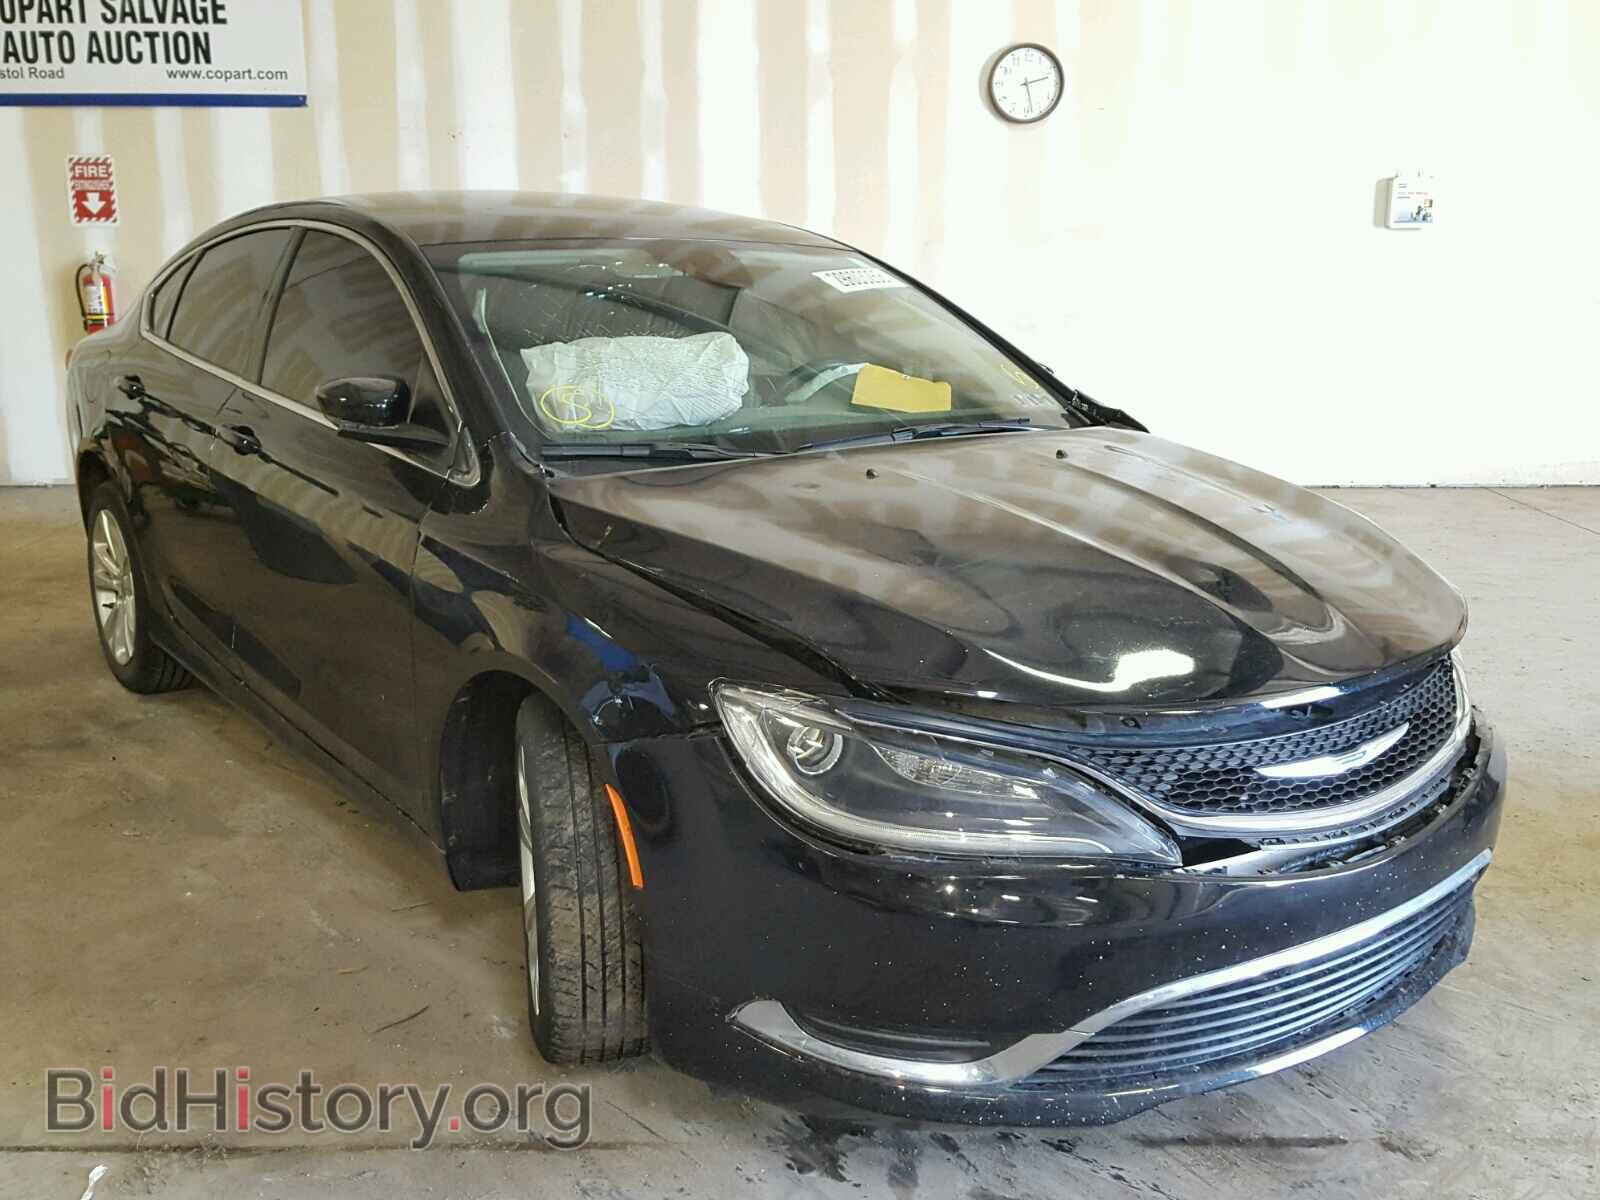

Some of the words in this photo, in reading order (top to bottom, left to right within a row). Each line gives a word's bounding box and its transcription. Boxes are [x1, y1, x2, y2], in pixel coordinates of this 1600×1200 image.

[100, 0, 228, 25] SALVAGE
[3, 30, 76, 64] AUTO
[86, 30, 212, 65] AUCTION
[28, 66, 65, 79] Road
[166, 68, 288, 82] www.copart.com
[74, 164, 108, 178] FIRE
